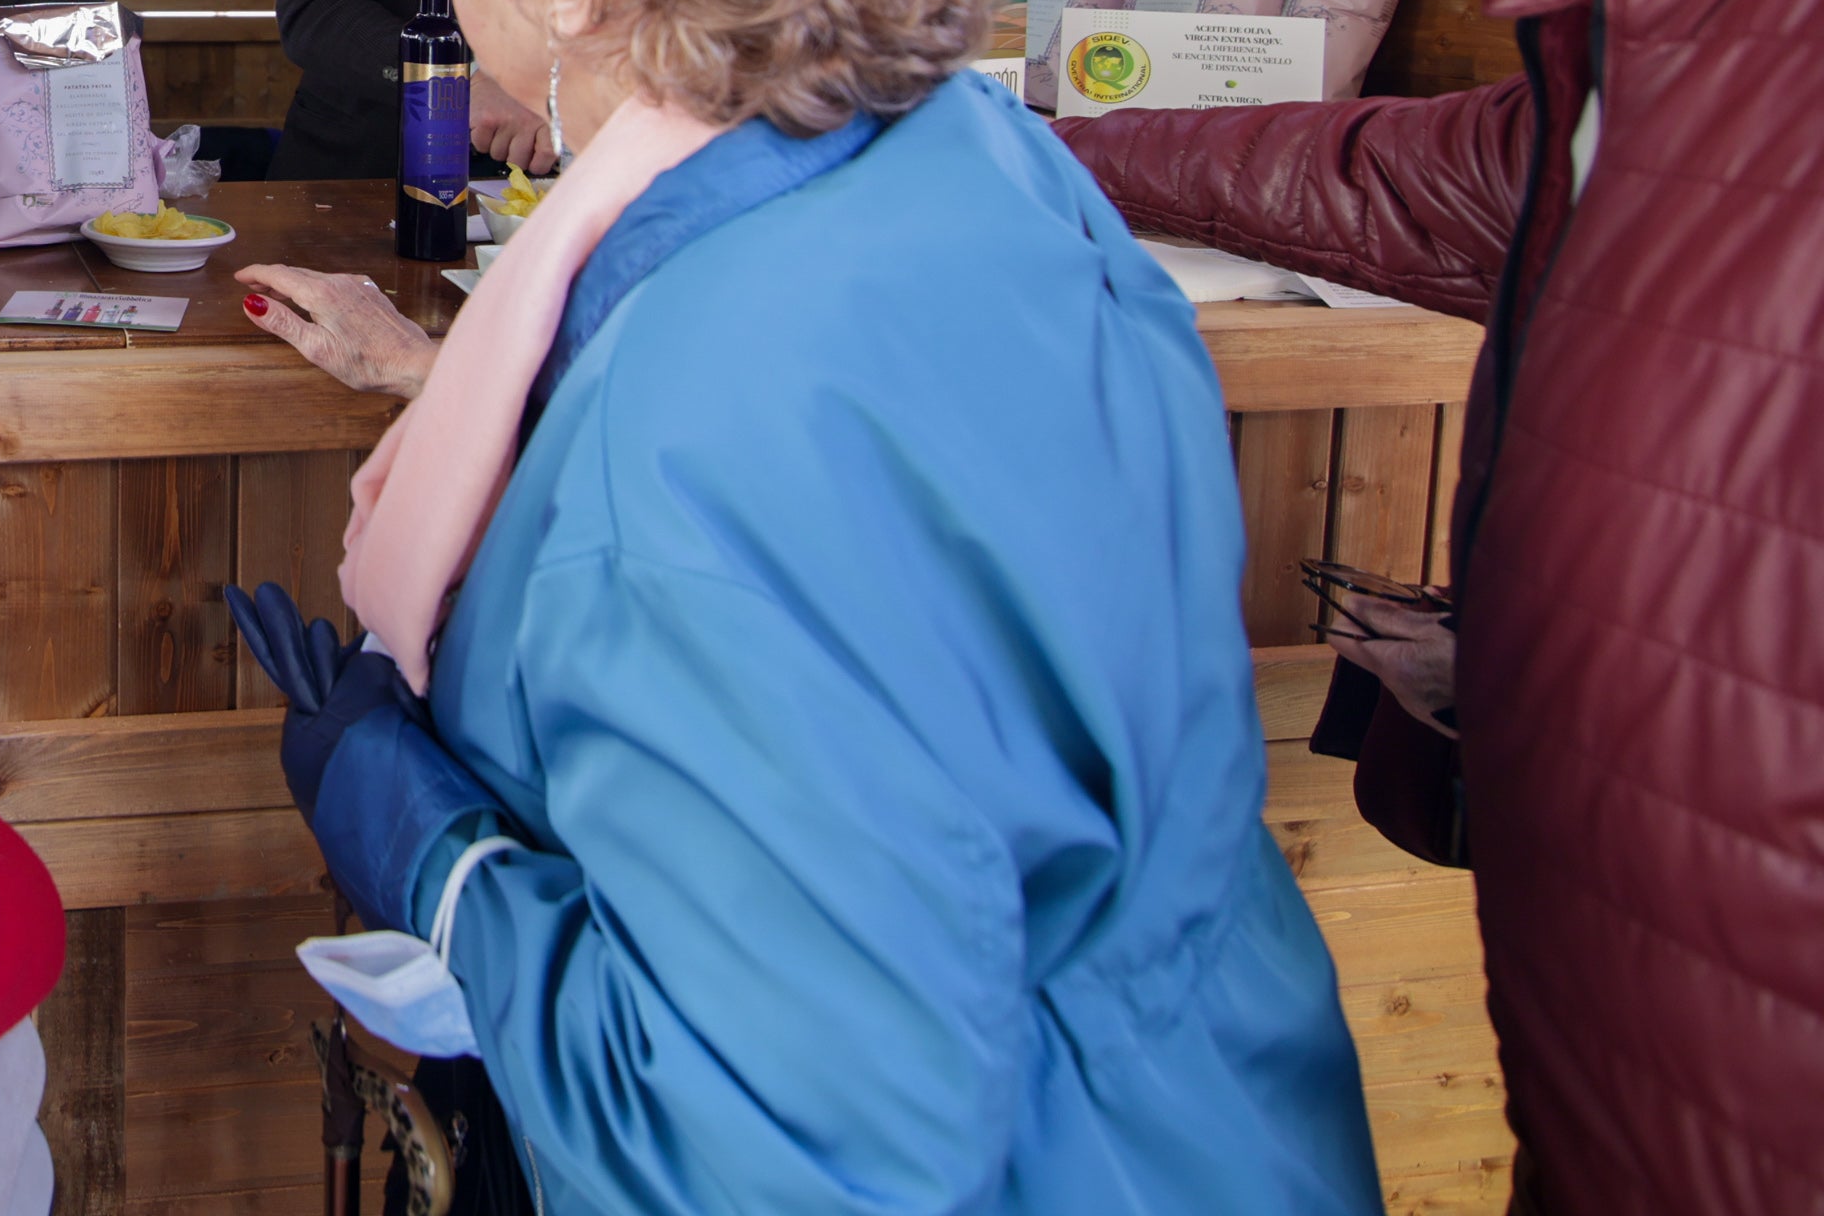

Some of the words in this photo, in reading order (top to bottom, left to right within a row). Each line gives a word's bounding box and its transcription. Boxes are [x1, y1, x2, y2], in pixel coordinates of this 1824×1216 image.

[1229, 26, 1242, 34] DE
[1244, 27, 1272, 35] OLIVA
[1184, 34, 1219, 42] VIRGEN
[1221, 36, 1251, 44] EXTRA
[1253, 38, 1283, 46] SIQEV.
[1213, 45, 1267, 54] DIFERENCIA
[1185, 53, 1238, 62] ENCUENTRA
[1216, 64, 1263, 73] DISTANCIA
[1094, 64, 1146, 100] INTERNATIONAL
[428, 79, 466, 110] ORO
[1198, 94, 1230, 102] EXTRA
[1230, 96, 1263, 104] VIRGIN
